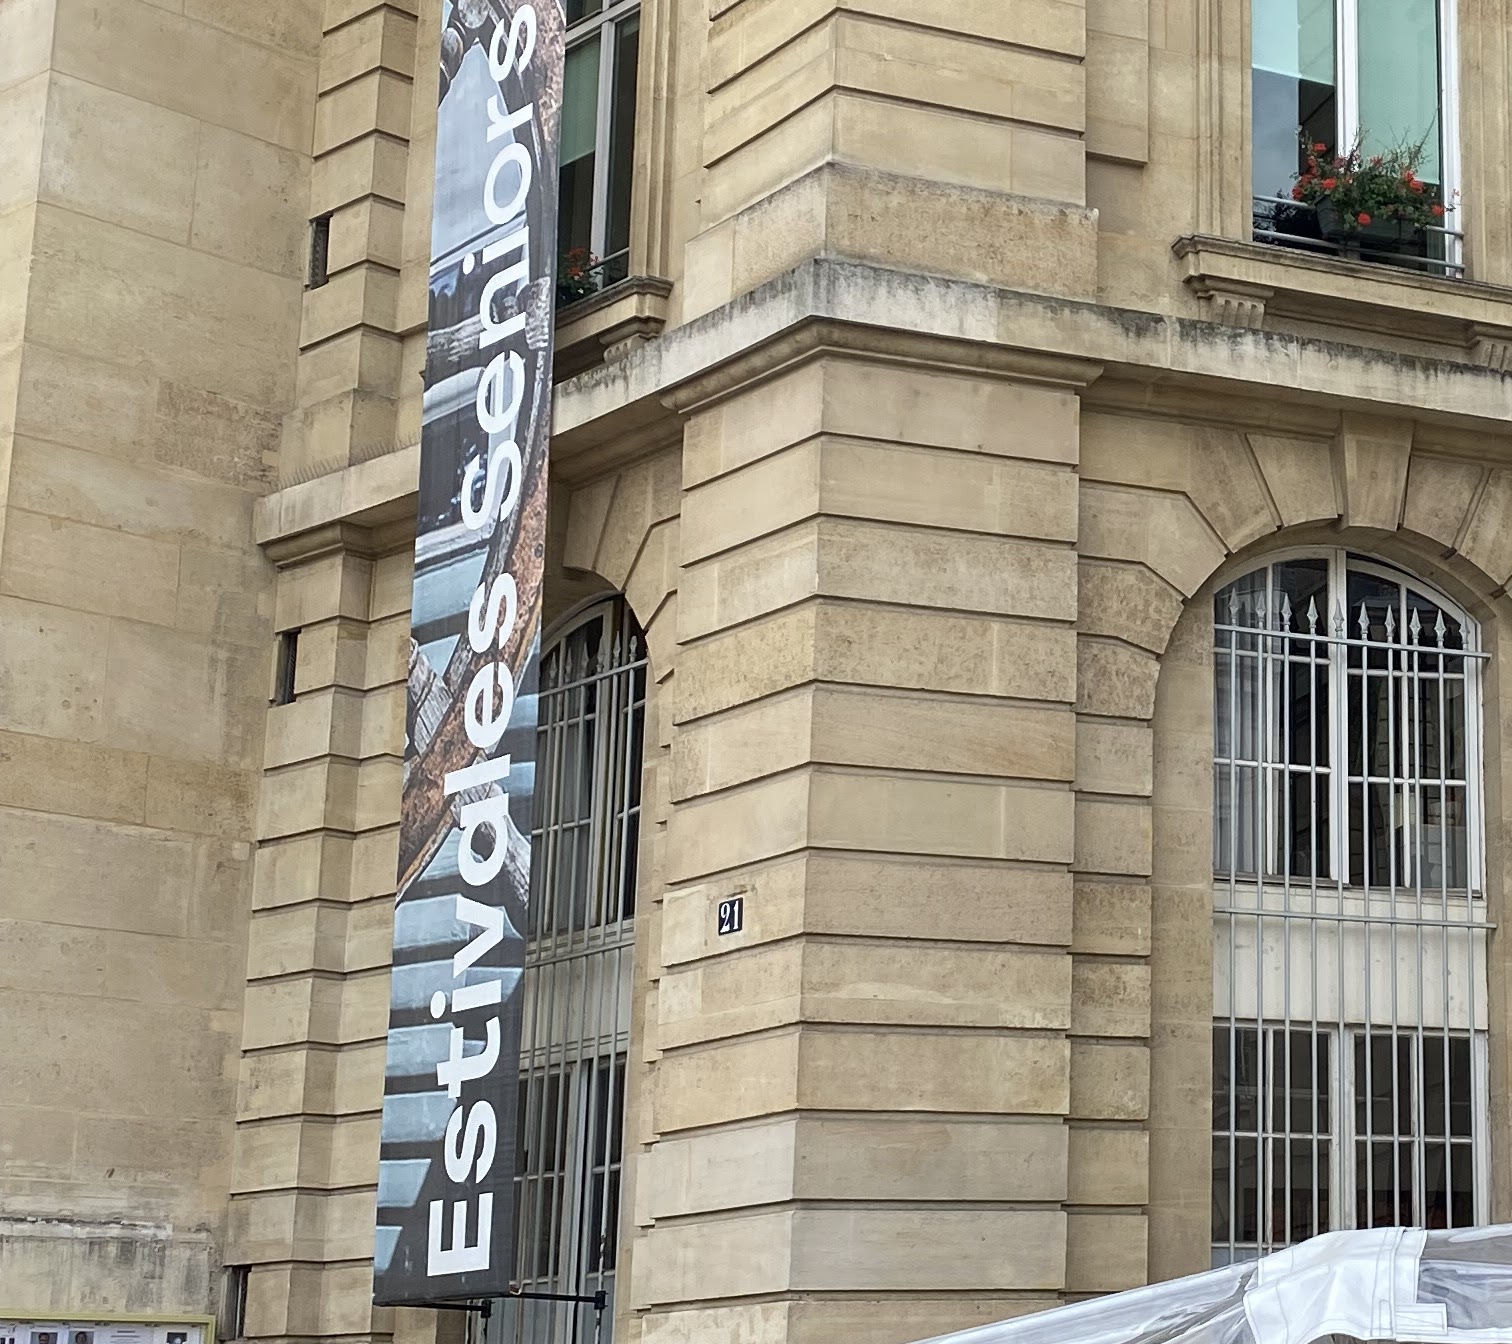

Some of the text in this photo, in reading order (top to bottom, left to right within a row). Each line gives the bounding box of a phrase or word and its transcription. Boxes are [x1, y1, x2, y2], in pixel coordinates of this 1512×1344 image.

[426, 2, 538, 1278] Estivales Seniors
[719, 899, 740, 934] 21
